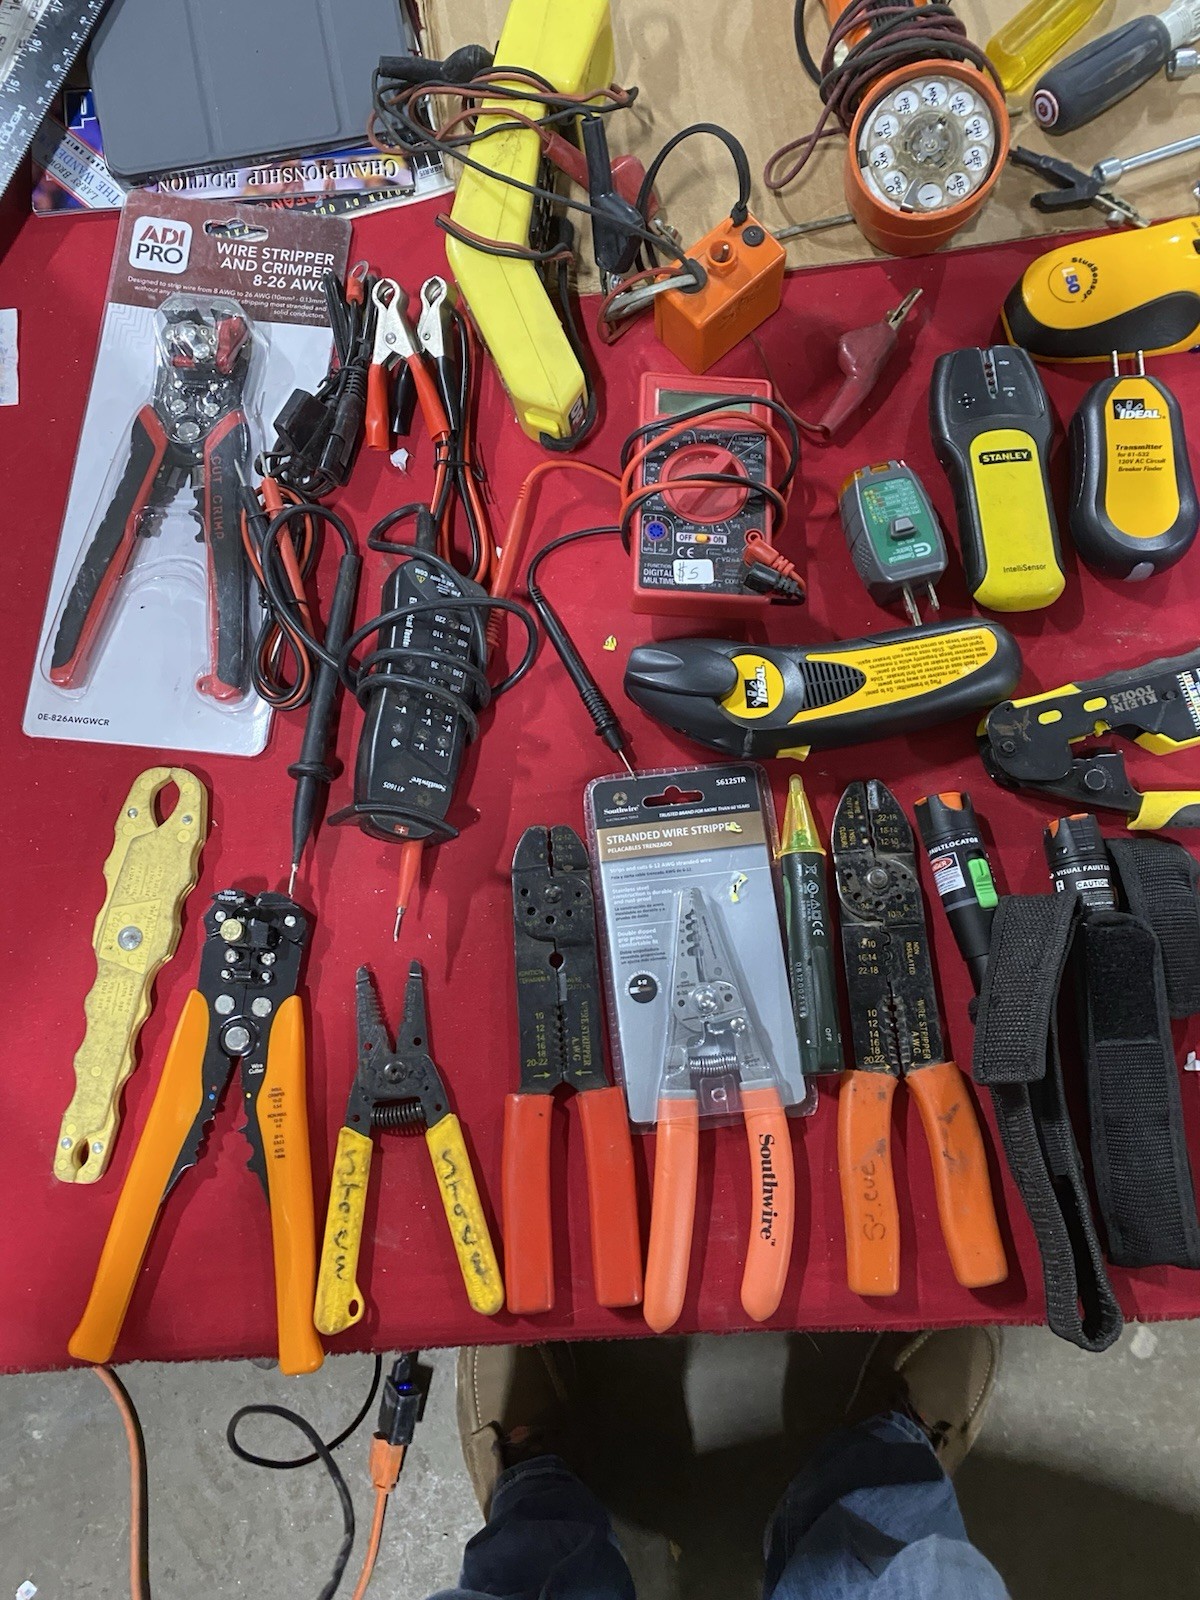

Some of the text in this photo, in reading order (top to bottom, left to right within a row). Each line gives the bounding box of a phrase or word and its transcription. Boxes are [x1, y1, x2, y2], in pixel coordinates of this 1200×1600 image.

[28, 39, 42, 53] 16
[6, 79, 20, 93] 15
[970, 150, 983, 168] DEF
[157, 158, 400, 194] CHAMPIONSHIP EDITION
[72, 176, 98, 201] LARRY
[954, 175, 966, 195] ABC
[95, 181, 120, 206] THE
[345, 198, 360, 208] BY
[140, 225, 187, 246] ADI
[135, 243, 184, 265] PRO
[216, 241, 336, 267] WIRE STRIPPER
[220, 257, 259, 273] AND
[127, 275, 160, 288] Designed
[167, 281, 182, 291] strip
[197, 285, 213, 294] from
[218, 288, 236, 296] AWG
[252, 274, 288, 291] 8-26
[1061, 265, 1082, 295] L50
[1070, 256, 1099, 303] StudSensor
[241, 299, 269, 308] stripping
[269, 301, 285, 309] most
[285, 302, 314, 311] stranded
[273, 308, 288, 316] solid
[1119, 407, 1161, 420] IDEAL
[1115, 443, 1164, 451] Transmitter
[981, 450, 1029, 463] STANLEY
[211, 456, 225, 539] CUT CRIMP
[713, 535, 725, 544] ON
[643, 568, 674, 578] DIGITAL
[1003, 563, 1047, 574] IntelliSensor
[434, 614, 447, 624] 220
[755, 665, 769, 703] IDEAL
[1109, 684, 1155, 704] TOOLS
[1112, 692, 1159, 714] KLEIN
[408, 775, 448, 793] Southwire
[715, 776, 747, 787] S612STR
[603, 803, 640, 816] Southwire
[606, 830, 661, 846] STRANDED
[661, 826, 689, 839] WIRE
[607, 840, 673, 854] PELACABLES TRENZADO
[675, 858, 700, 867] stranded
[1055, 866, 1082, 878] VISUAL
[858, 965, 880, 975] 22-18
[867, 1009, 878, 1018] 10
[536, 1024, 545, 1032] 12
[868, 1020, 879, 1028] 12
[917, 999, 932, 1060] WIRE STRIPPER
[824, 1026, 833, 1042] OFF
[869, 1030, 880, 1038] 14
[571, 1036, 582, 1061] AWG
[582, 1023, 593, 1067] STRIPPER
[870, 1039, 881, 1047] 16
[537, 1050, 547, 1058] 18
[870, 1046, 881, 1055] 18
[526, 1058, 549, 1068] 20-22
